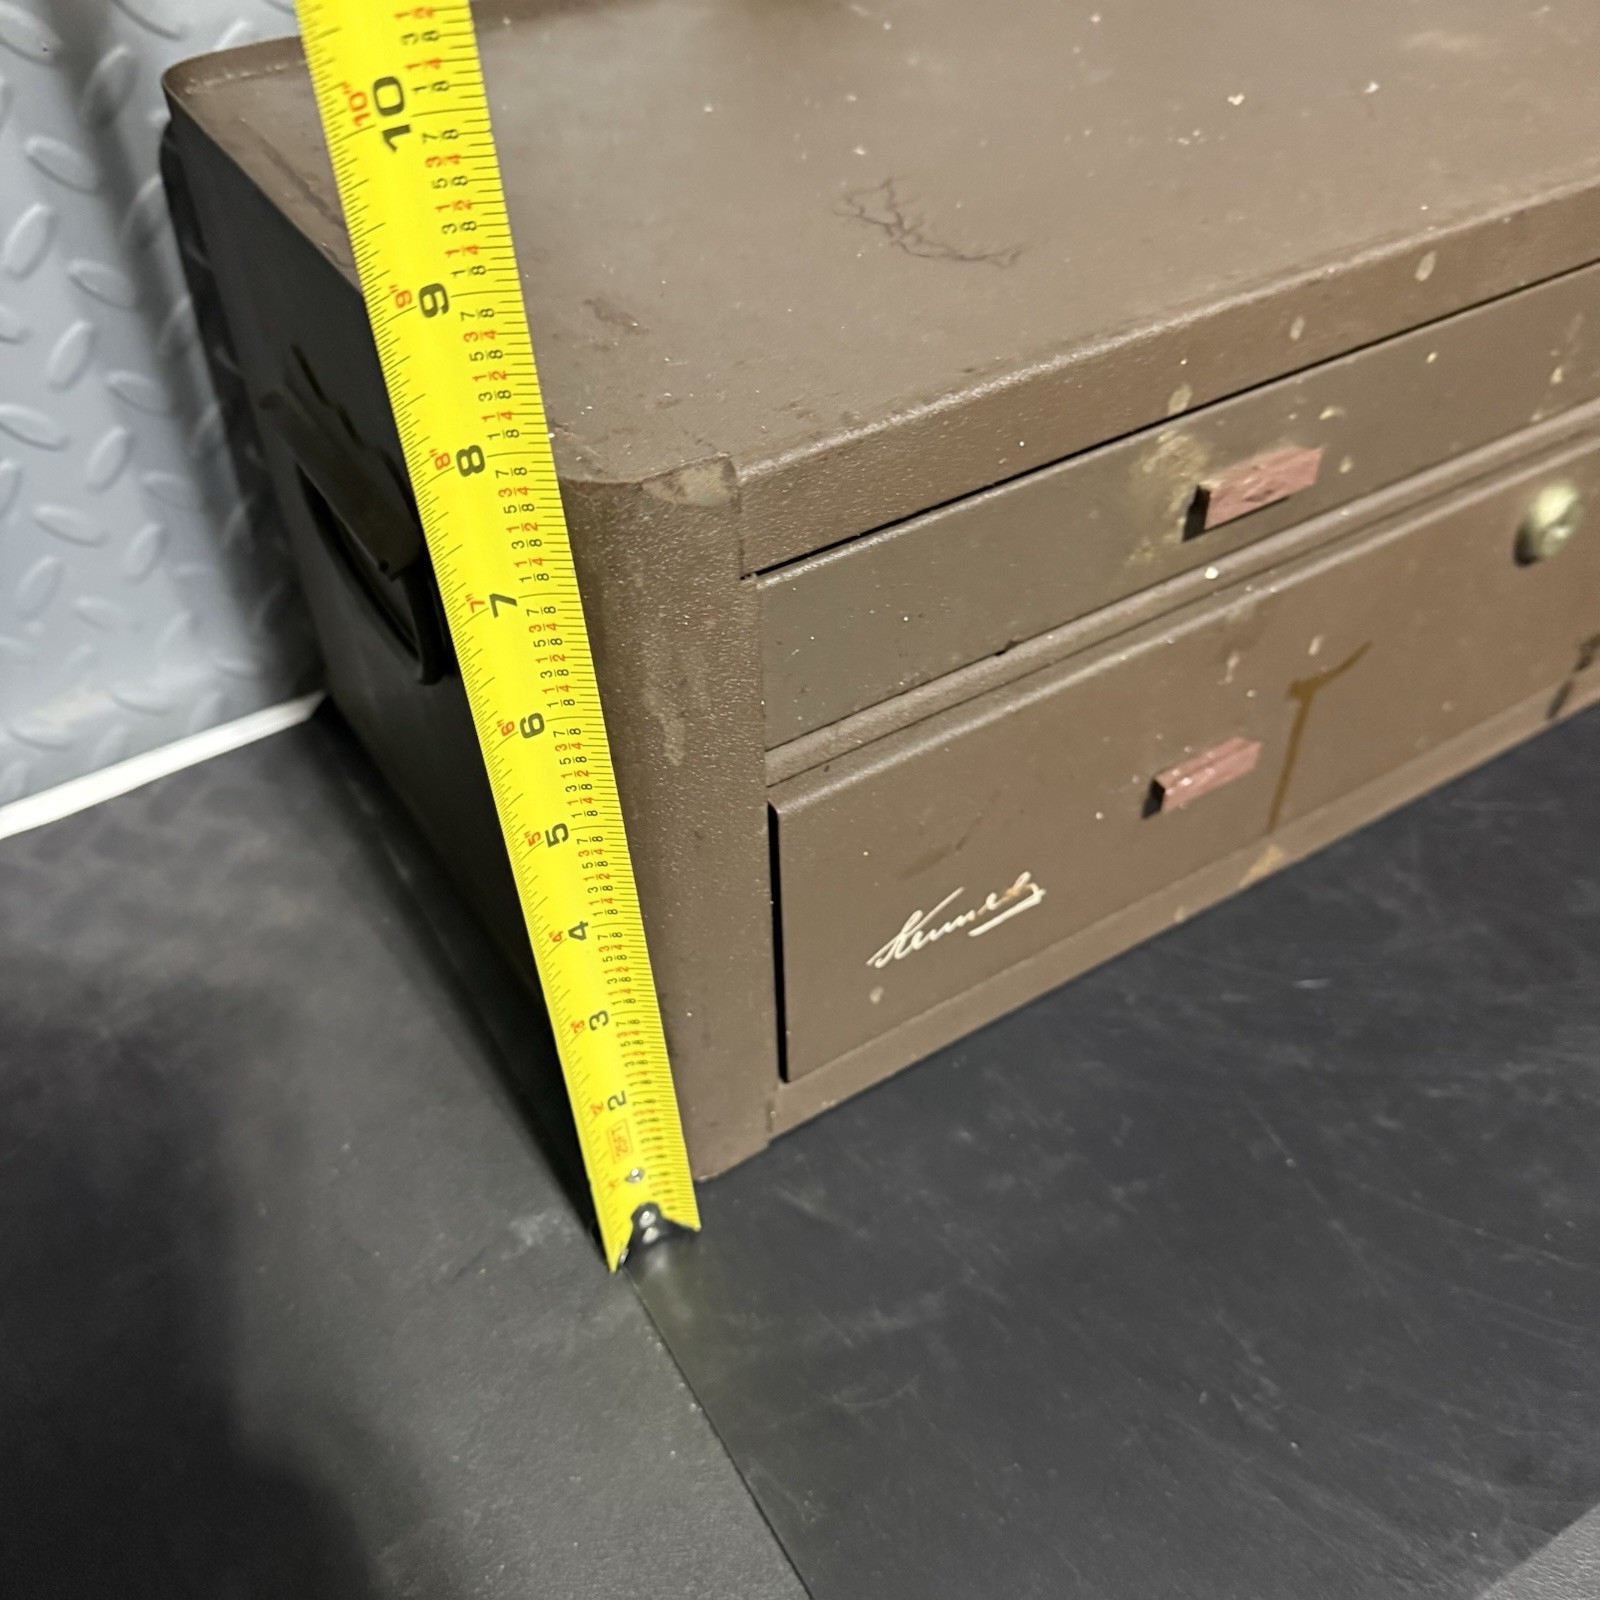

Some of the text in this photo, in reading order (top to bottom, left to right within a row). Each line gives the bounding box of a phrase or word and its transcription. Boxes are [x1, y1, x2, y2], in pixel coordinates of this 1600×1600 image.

[373, 75, 411, 154] 10
[418, 282, 449, 318] 9
[456, 445, 486, 477] 8
[489, 593, 518, 618] 7
[519, 712, 545, 739] 6
[545, 822, 569, 848] 5
[568, 920, 588, 941] 4
[588, 1010, 609, 1031] 3
[607, 1090, 626, 1111] 2
